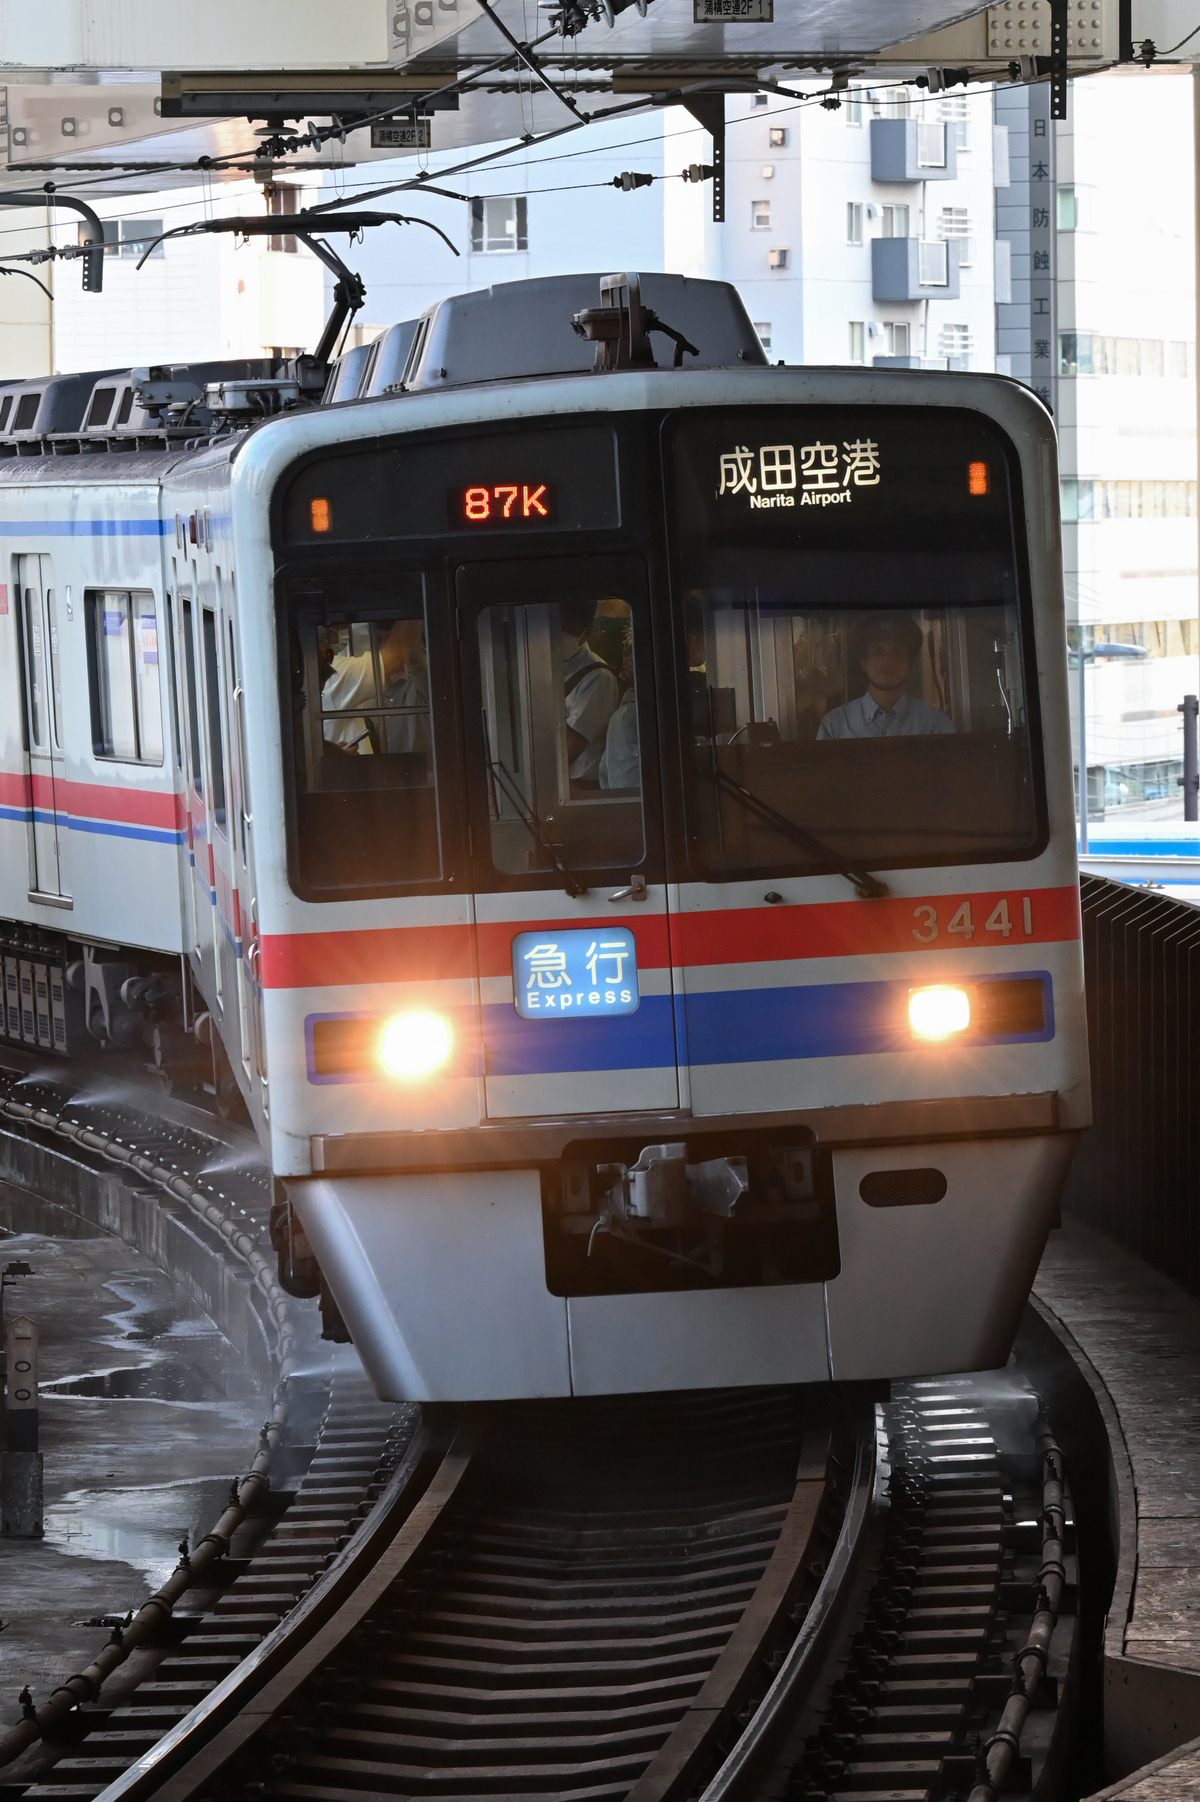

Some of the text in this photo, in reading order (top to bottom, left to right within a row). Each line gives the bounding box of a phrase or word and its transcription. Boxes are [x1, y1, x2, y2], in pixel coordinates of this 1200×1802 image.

[758, 0, 763, 15] 1
[418, 130, 424, 142] 2
[719, 438, 881, 496] 成田空港
[465, 484, 548, 519] 87K
[750, 489, 852, 509] Narita Airport
[911, 896, 1033, 943] 3441
[523, 941, 630, 989] 急行
[527, 989, 632, 1010] Express
